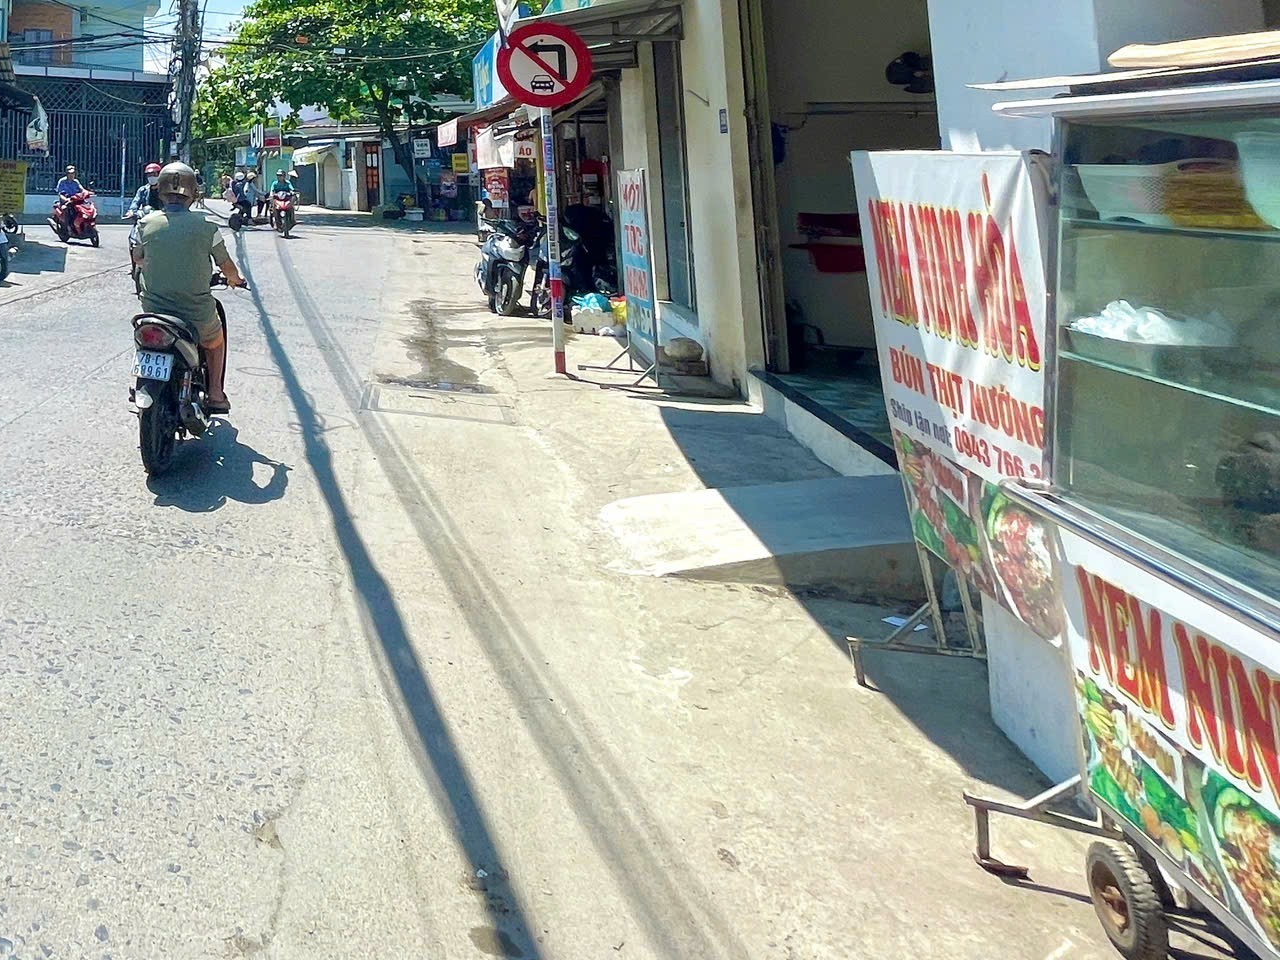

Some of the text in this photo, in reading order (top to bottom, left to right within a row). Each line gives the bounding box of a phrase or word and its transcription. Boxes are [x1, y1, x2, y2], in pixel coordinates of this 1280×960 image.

[889, 345, 926, 397] BÚN
[926, 361, 965, 419] THỊT
[954, 425, 992, 468] 0943
[1076, 564, 1177, 731] NEM
